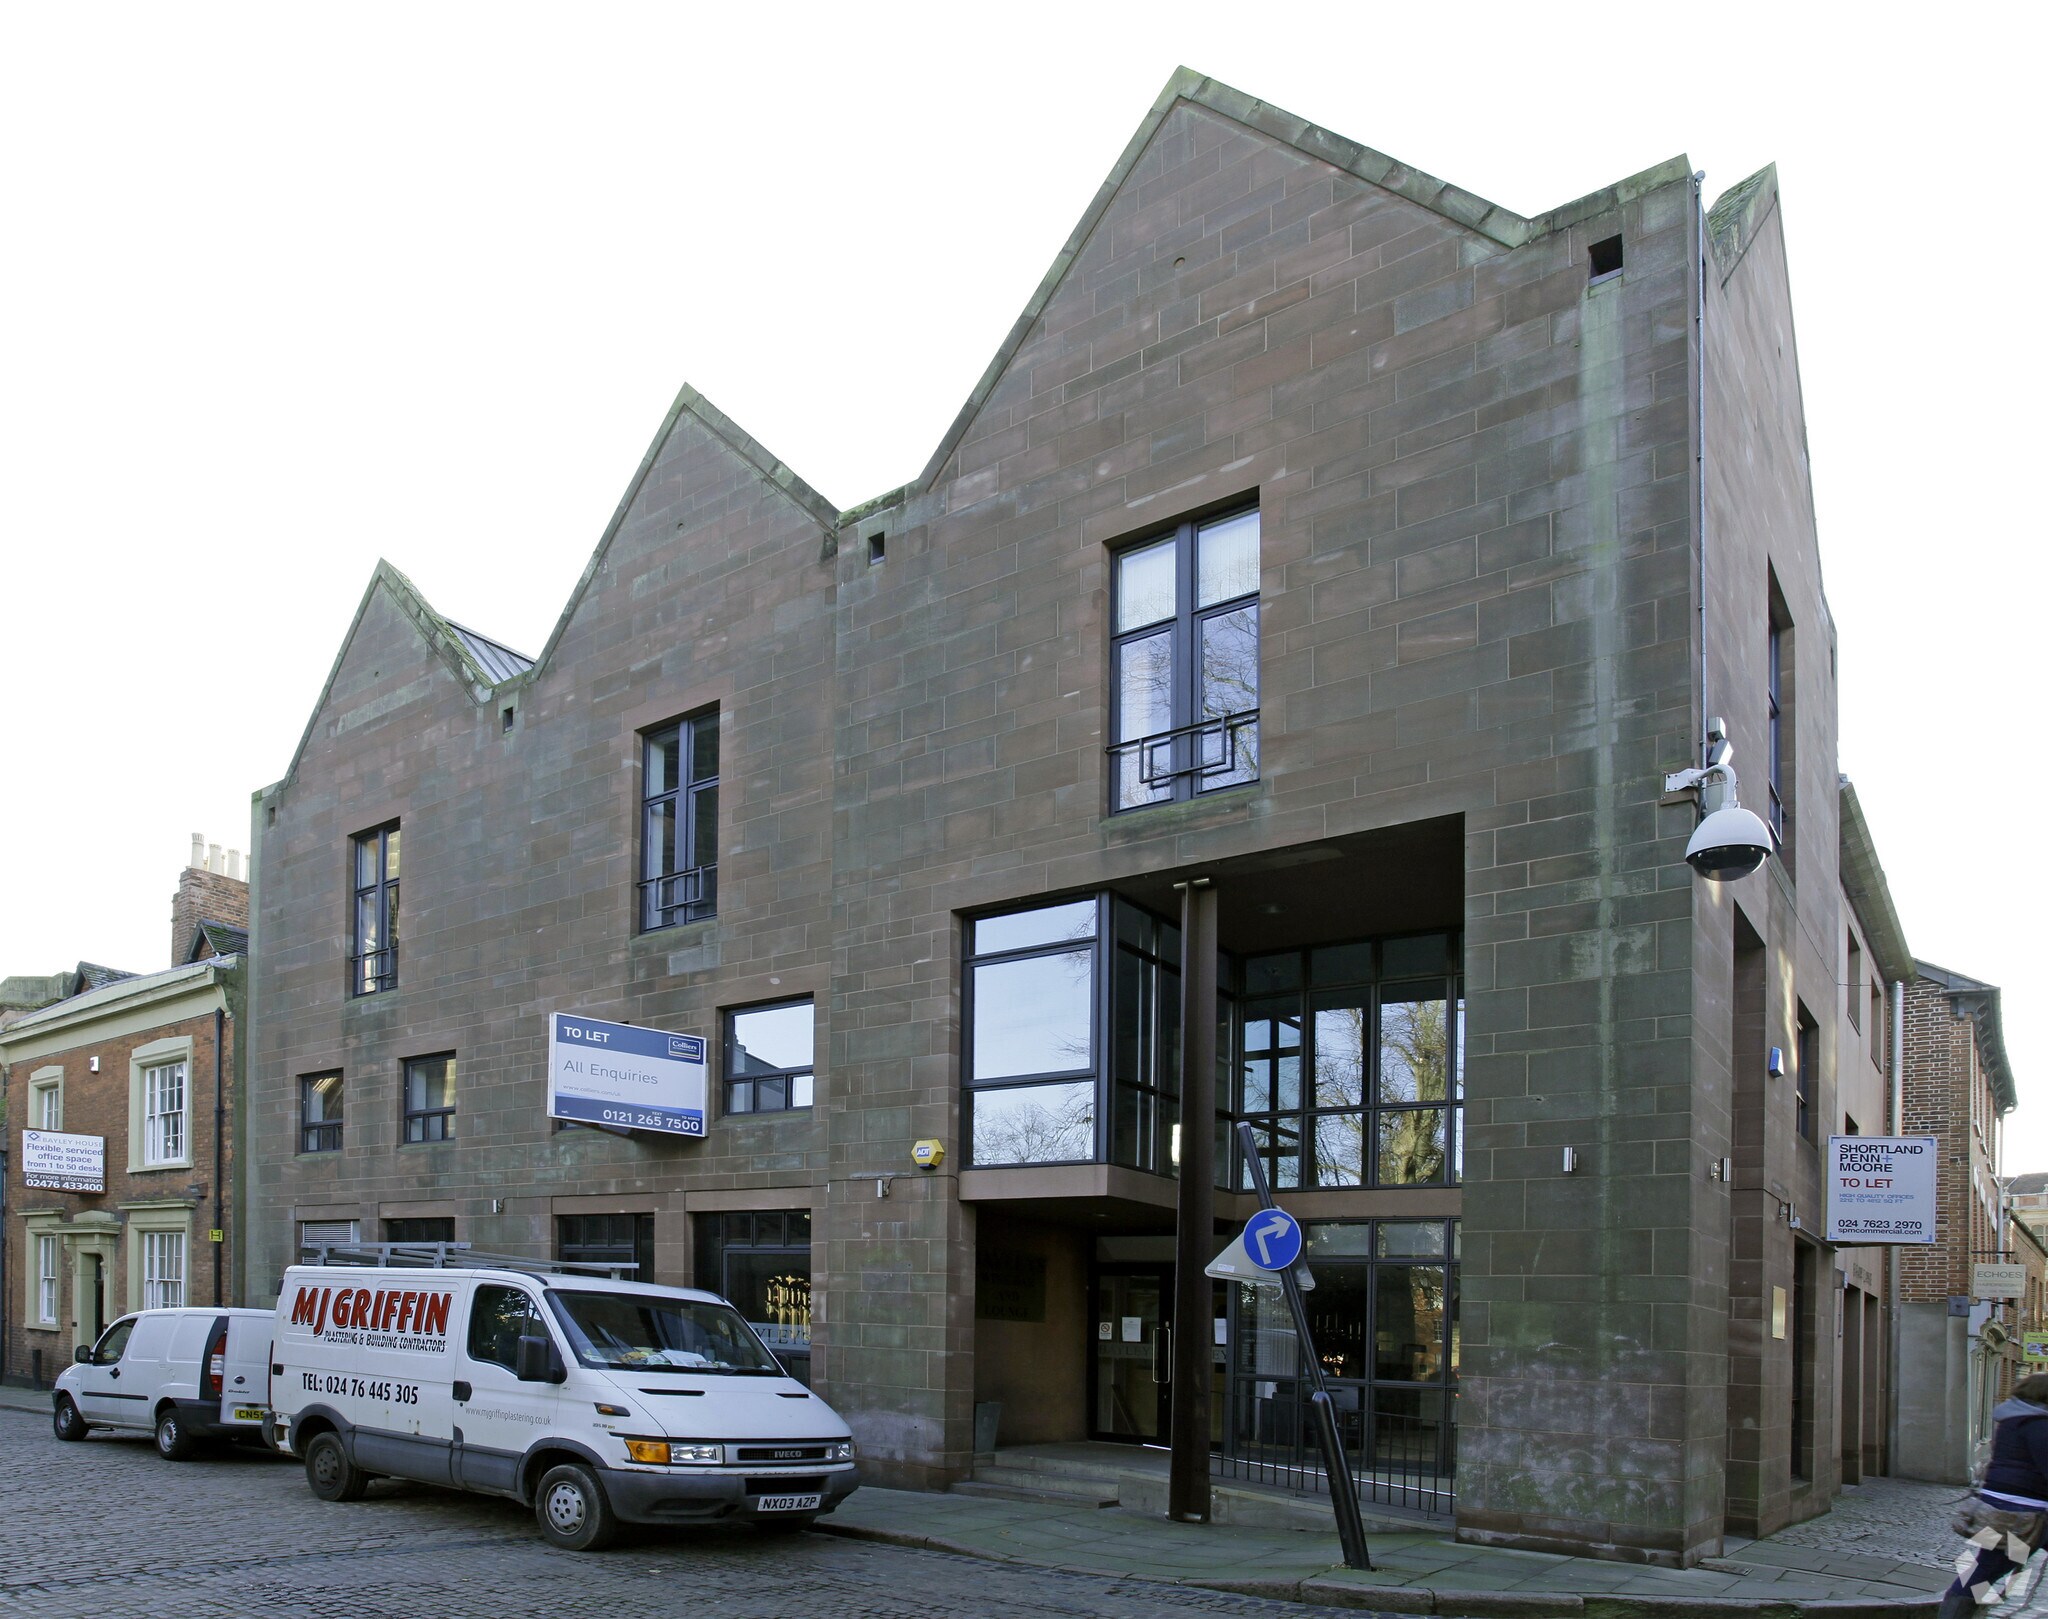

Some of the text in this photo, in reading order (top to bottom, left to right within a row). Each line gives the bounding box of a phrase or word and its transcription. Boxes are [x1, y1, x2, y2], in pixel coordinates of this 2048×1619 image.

[563, 1026, 610, 1043] TO LET
[672, 1040, 697, 1050] Colliers
[563, 1060, 659, 1085] All Enquiries
[603, 1109, 699, 1131] 0121 265 7500
[42, 1137, 73, 1145] BAYLEY
[26, 1143, 103, 1156] Flexible, serviced
[917, 1148, 929, 1156] ADT
[1839, 1144, 1923, 1155] SHORTLAND
[27, 1160, 47, 1168] from
[37, 1153, 93, 1164] office space
[1839, 1163, 1893, 1173] MOORE
[26, 1179, 103, 1192] 02476 433400
[60, 1176, 103, 1184] information
[1840, 1178, 1893, 1188] TO LET
[1838, 1219, 1922, 1230] 024 7623 2970
[1838, 1227, 1922, 1235] spmcommercial.com
[1976, 1270, 2023, 1279] ECHOES
[291, 1287, 452, 1337] MJ GRIFFIN
[323, 1330, 446, 1353] PLASTERING & BUILDING CONTRACTORS
[302, 1372, 419, 1405] TEL: 024 76 445 305
[465, 1407, 551, 1426] www.mjgriffinplastering.co.uk
[774, 1450, 802, 1458] IVECO
[762, 1496, 817, 1510] NX03 AZP
